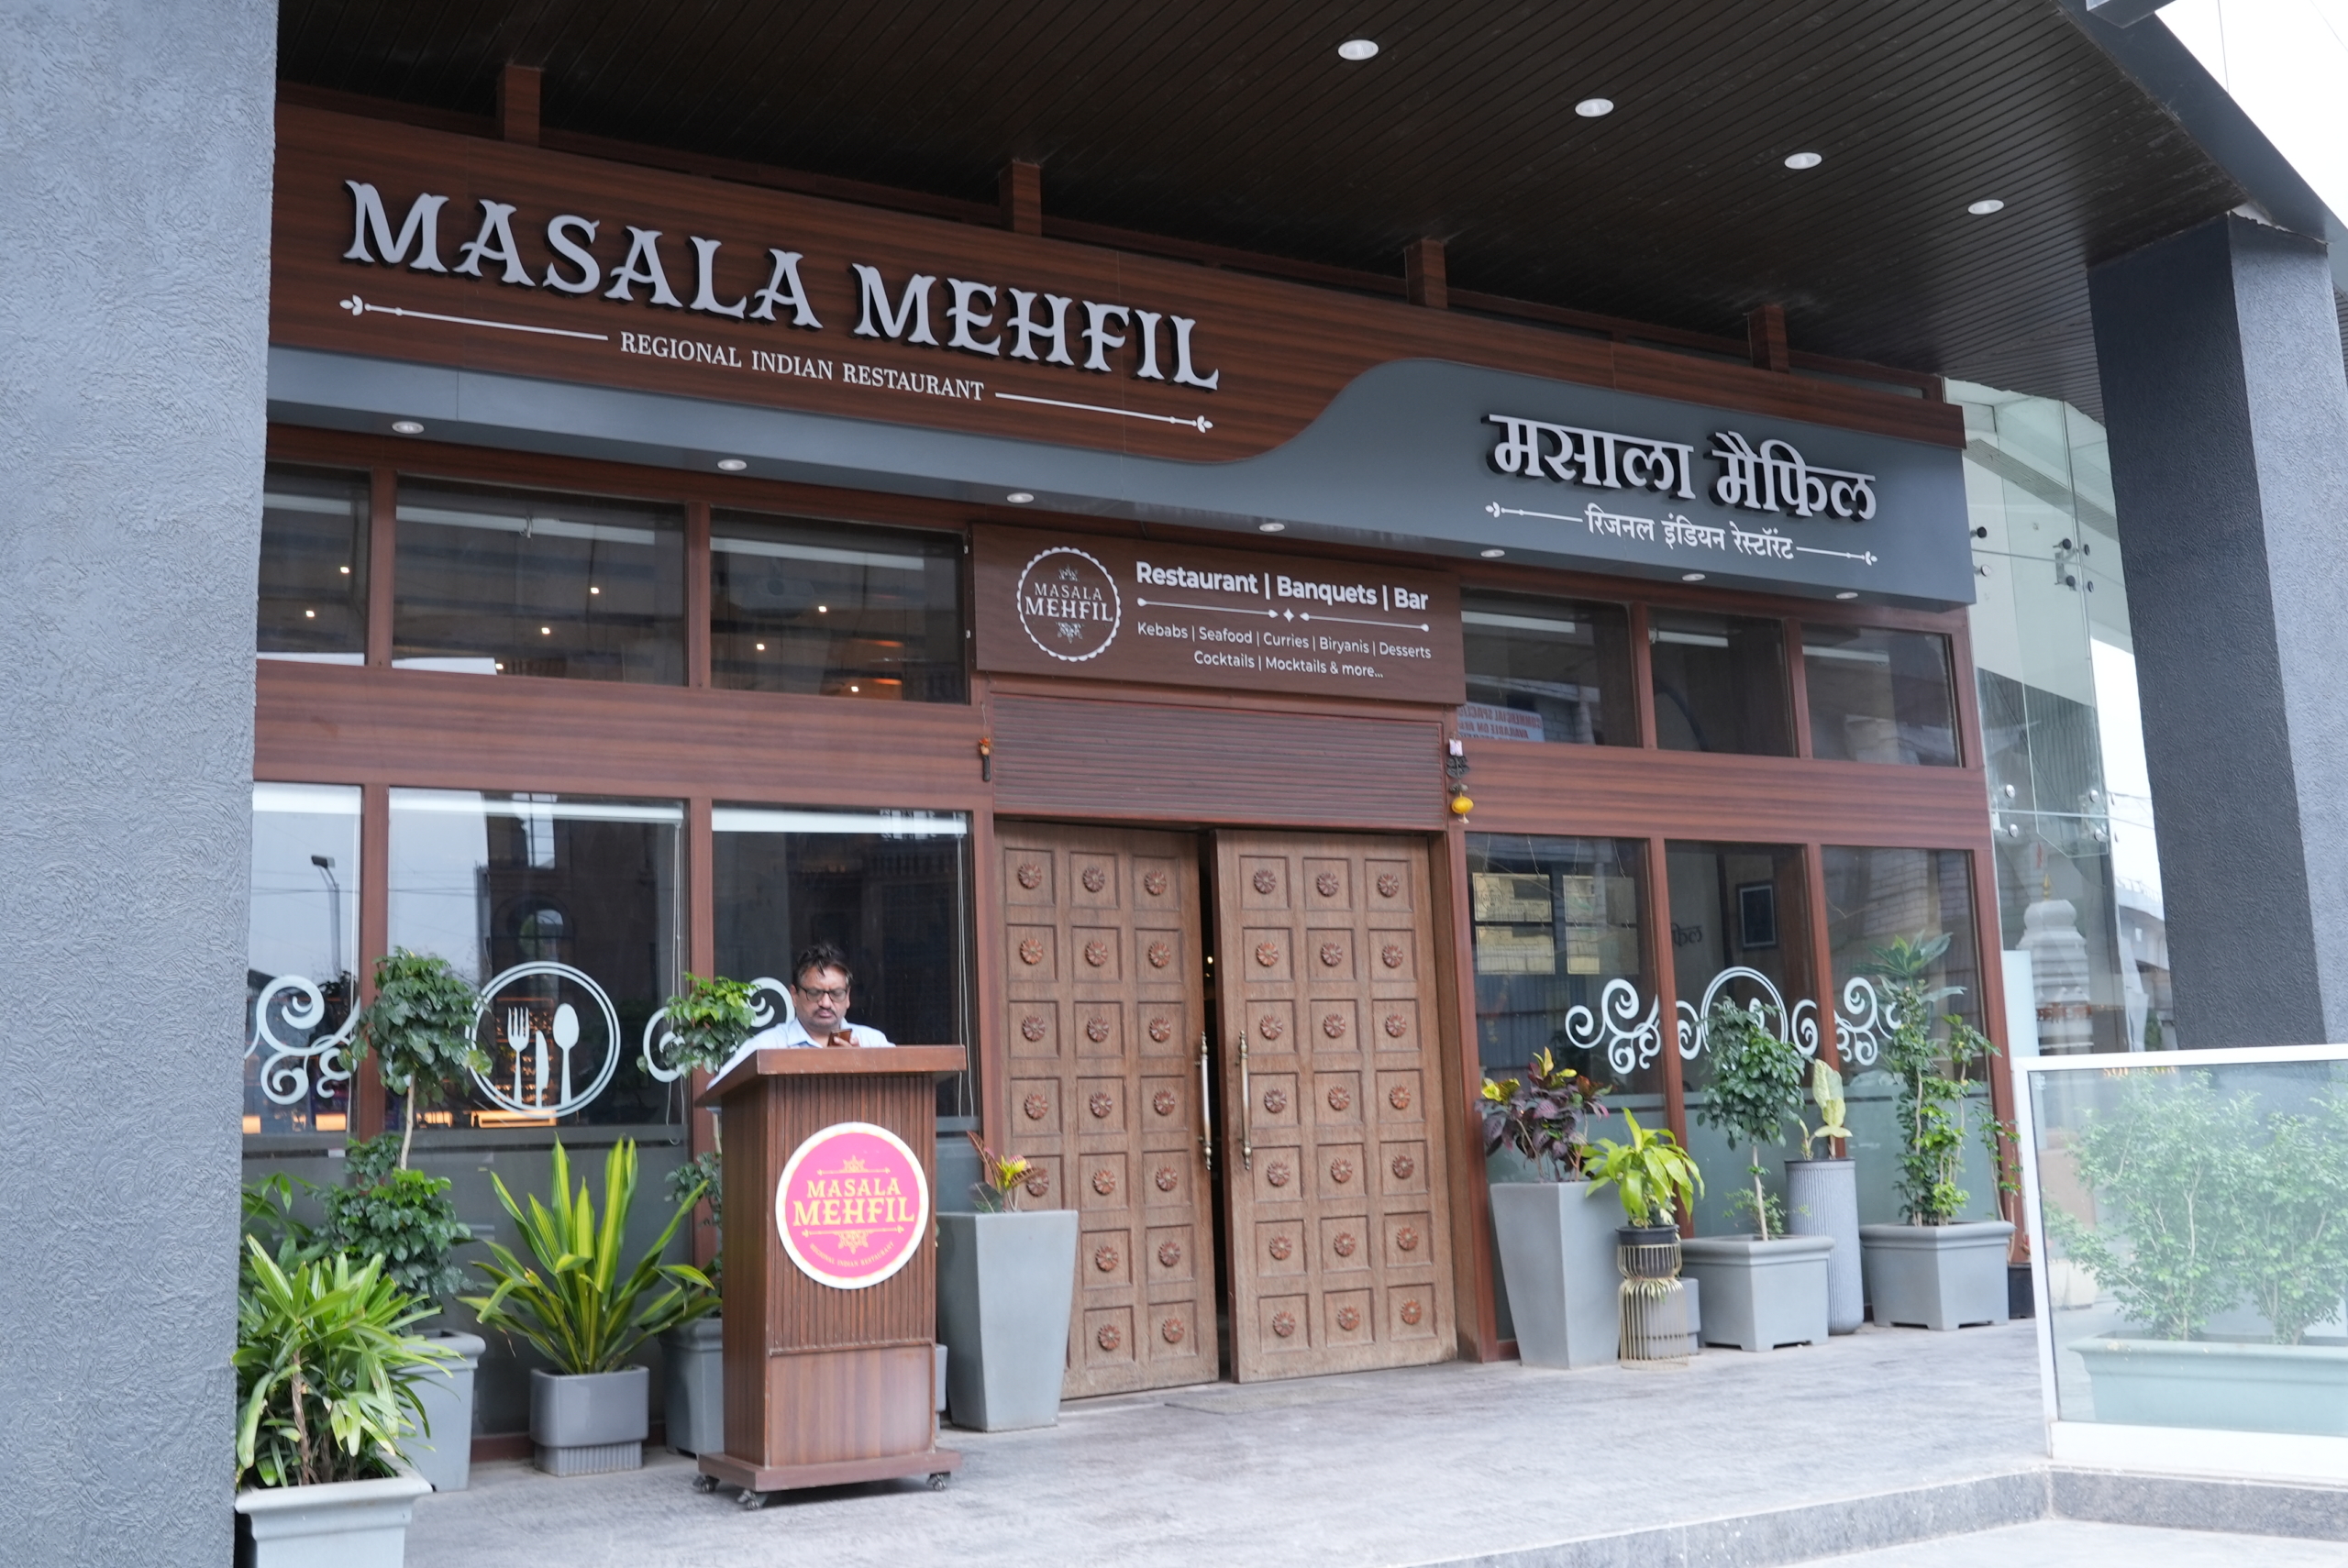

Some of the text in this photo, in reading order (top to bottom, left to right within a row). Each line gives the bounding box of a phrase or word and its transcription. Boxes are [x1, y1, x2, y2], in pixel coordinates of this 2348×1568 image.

[343, 180, 1219, 391] MASALA MEHFIL
[621, 331, 984, 401] REGIONAL INDIAN RESTAURANT
[1488, 414, 1877, 521] मसाला मैफिल
[1584, 502, 1795, 560] रिजनल इंडियन रेस्टॉरंट
[1034, 582, 1102, 602] MASALA
[1135, 560, 1259, 594] Restaurant
[1277, 574, 1378, 606] Banquets
[1393, 587, 1429, 611] Bar
[1025, 596, 1113, 623] MEHFIL
[1137, 621, 1189, 639] Kebabs
[1199, 626, 1253, 645] Seafood
[1263, 632, 1310, 649] Curries
[1319, 635, 1370, 655] Biryanis
[1379, 642, 1432, 659] Desserts
[1193, 649, 1256, 669] Cocktails
[1265, 656, 1327, 674] Mocktails
[1330, 660, 1339, 675] &
[806, 1176, 903, 1198] MASALA
[792, 1196, 915, 1227] MEHFIL
[836, 1258, 858, 1267] INDIAN
